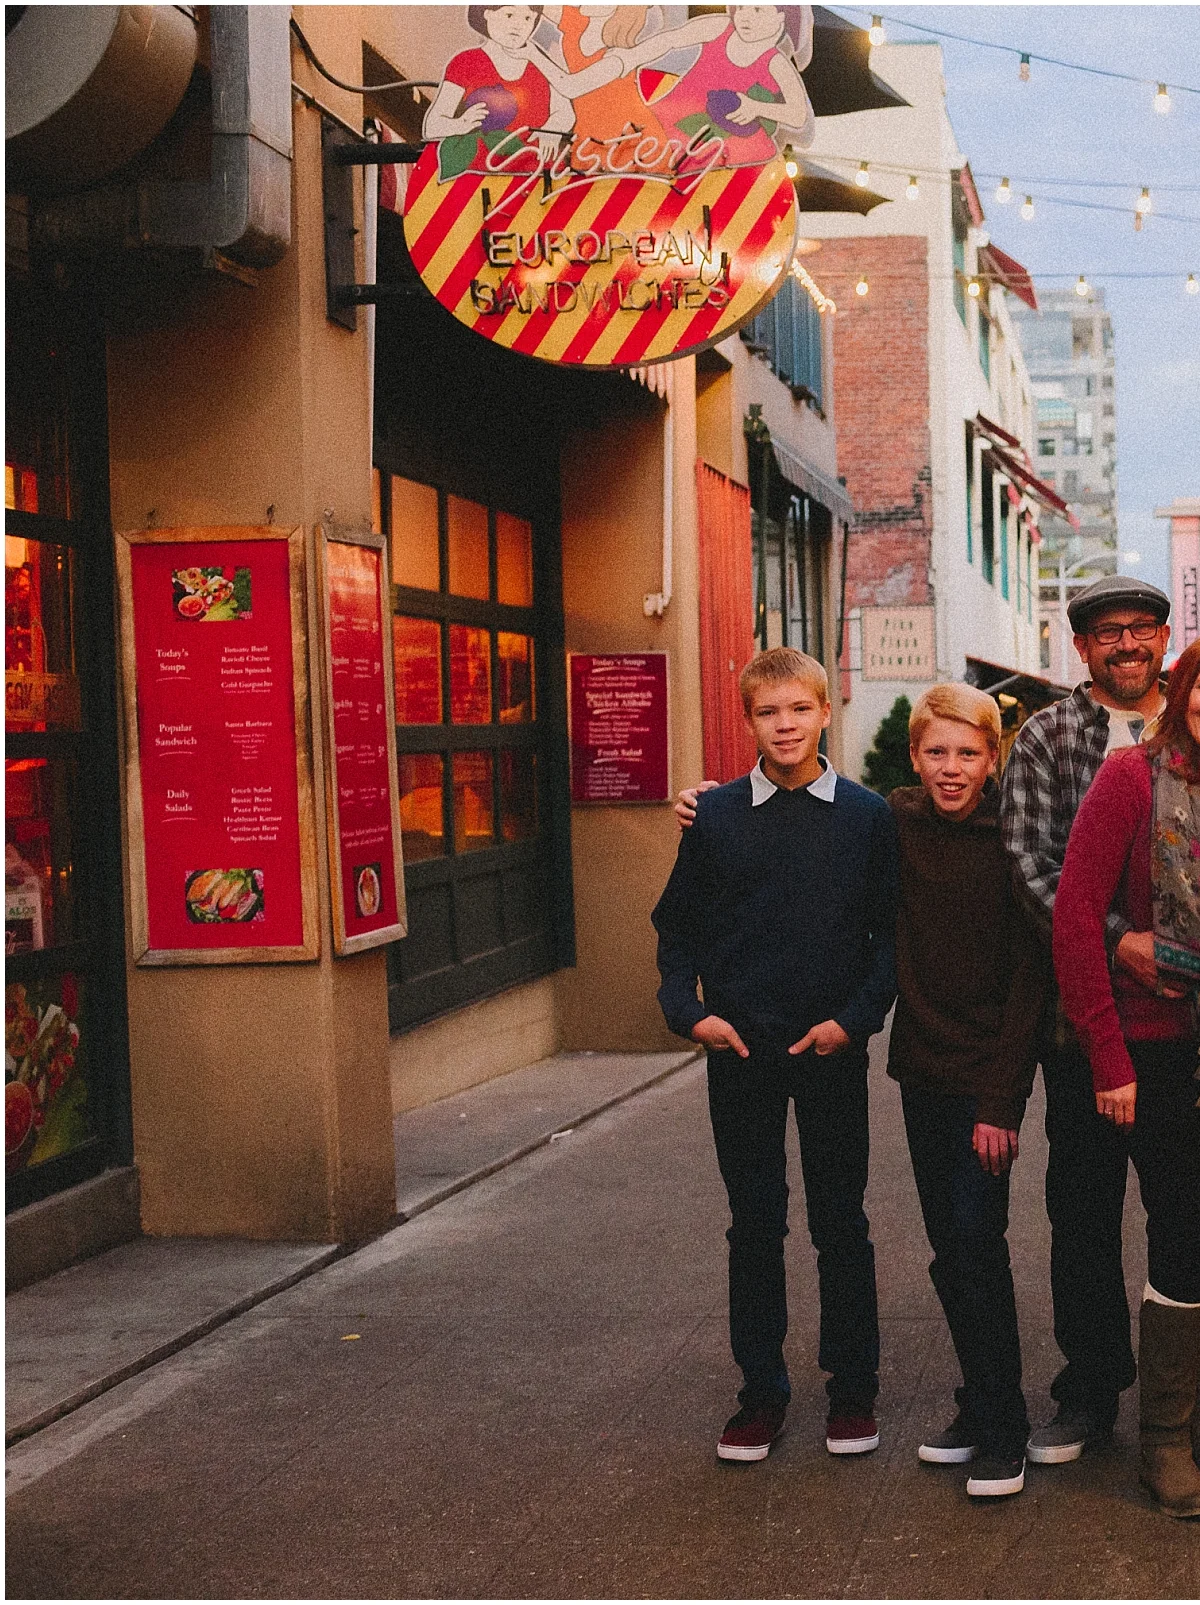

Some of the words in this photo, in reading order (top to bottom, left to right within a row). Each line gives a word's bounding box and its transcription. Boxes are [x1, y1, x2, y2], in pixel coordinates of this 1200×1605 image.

[488, 229, 712, 267] EUROPEAN
[473, 280, 731, 314] SANDWICHES
[155, 648, 189, 660] Today's
[159, 663, 186, 674] Soups
[159, 723, 192, 735] Popular
[155, 737, 197, 746] Sandwich
[167, 789, 190, 801] Daily
[165, 803, 193, 812] Salads
